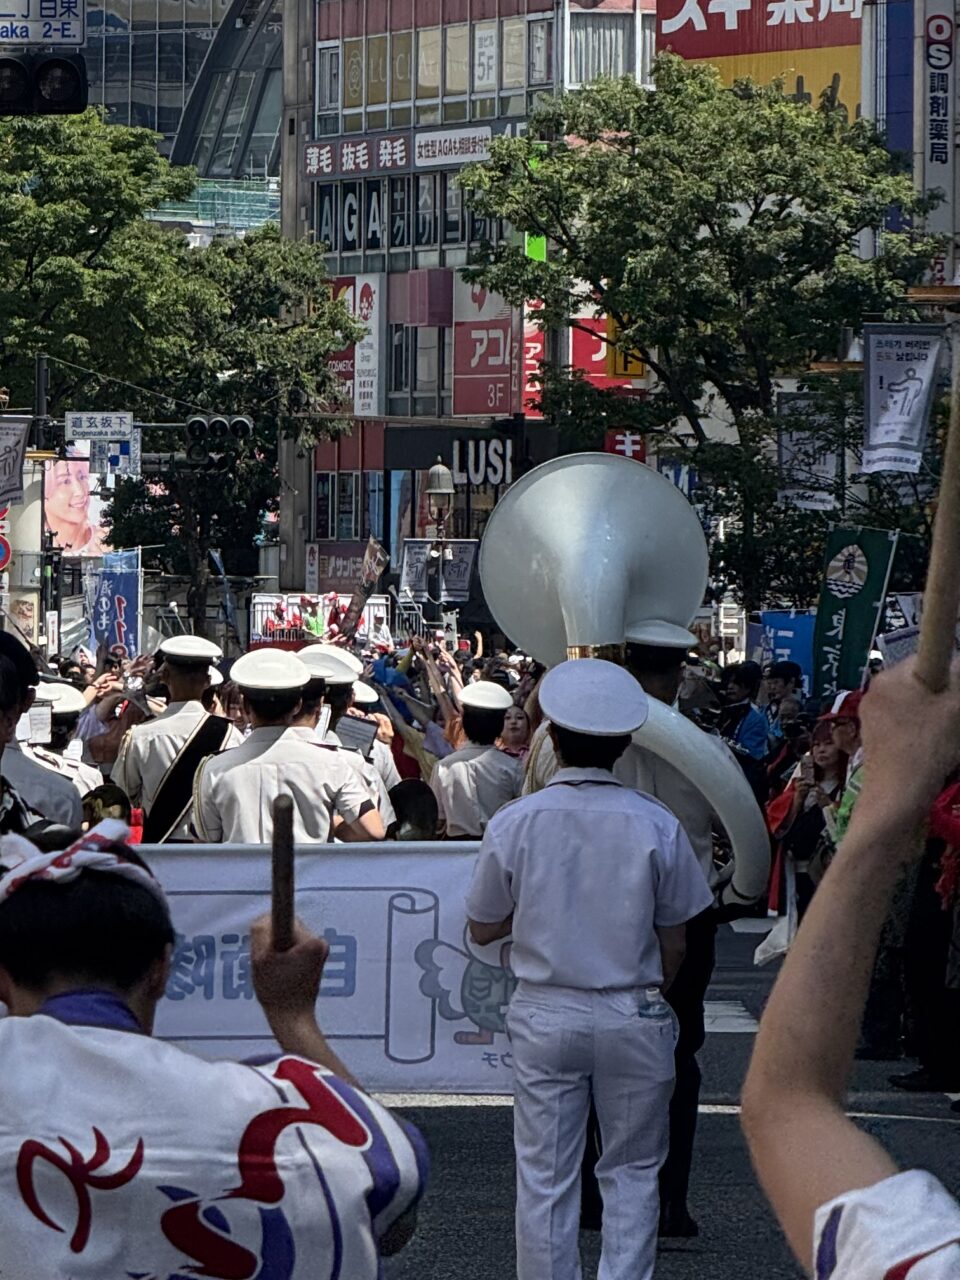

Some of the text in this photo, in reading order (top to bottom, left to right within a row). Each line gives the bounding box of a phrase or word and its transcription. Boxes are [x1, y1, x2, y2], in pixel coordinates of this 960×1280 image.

[42, 22, 76, 39] 2-E.
[476, 51, 495, 83] 5F
[929, 72, 949, 165] 調剤薬局
[306, 137, 407, 175] 薄毛 抜毛 発毛
[320, 190, 382, 243] AGA
[470, 328, 511, 369] アコ
[328, 360, 354, 372] COSMETIC
[487, 383, 504, 408] 3F
[71, 416, 127, 429] 道玄坂下
[72, 429, 109, 438] Dogenzaka
